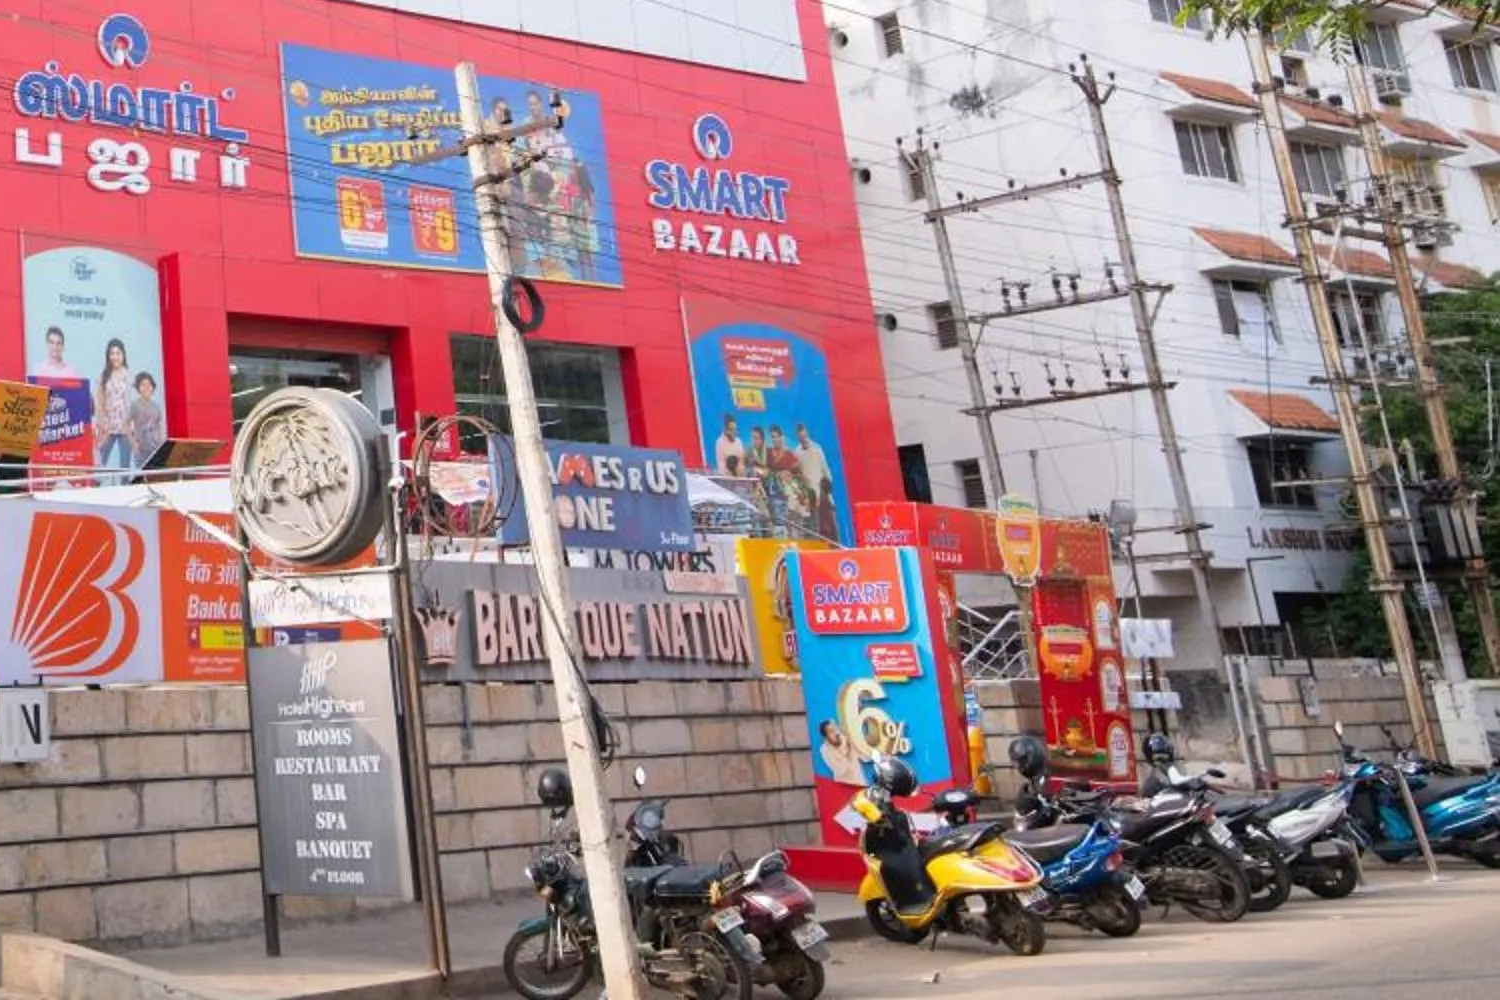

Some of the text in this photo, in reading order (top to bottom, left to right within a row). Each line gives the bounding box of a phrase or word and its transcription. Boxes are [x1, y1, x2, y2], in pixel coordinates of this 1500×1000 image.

[15, 127, 251, 195] பஜார்
[645, 159, 792, 224] SMART
[652, 218, 801, 265] BAZAAR
[644, 459, 680, 495] US
[555, 495, 616, 532] ONE
[187, 593, 228, 619] Bank
[812, 581, 892, 606] SMART
[474, 589, 754, 666] BARQUE NATION
[815, 607, 896, 624] BAZAAR
[296, 727, 352, 747] ROOMS
[274, 754, 381, 776] RESTAURANT
[312, 782, 347, 801] BAR
[315, 811, 348, 831] SPA
[295, 839, 373, 860] BANQUET
